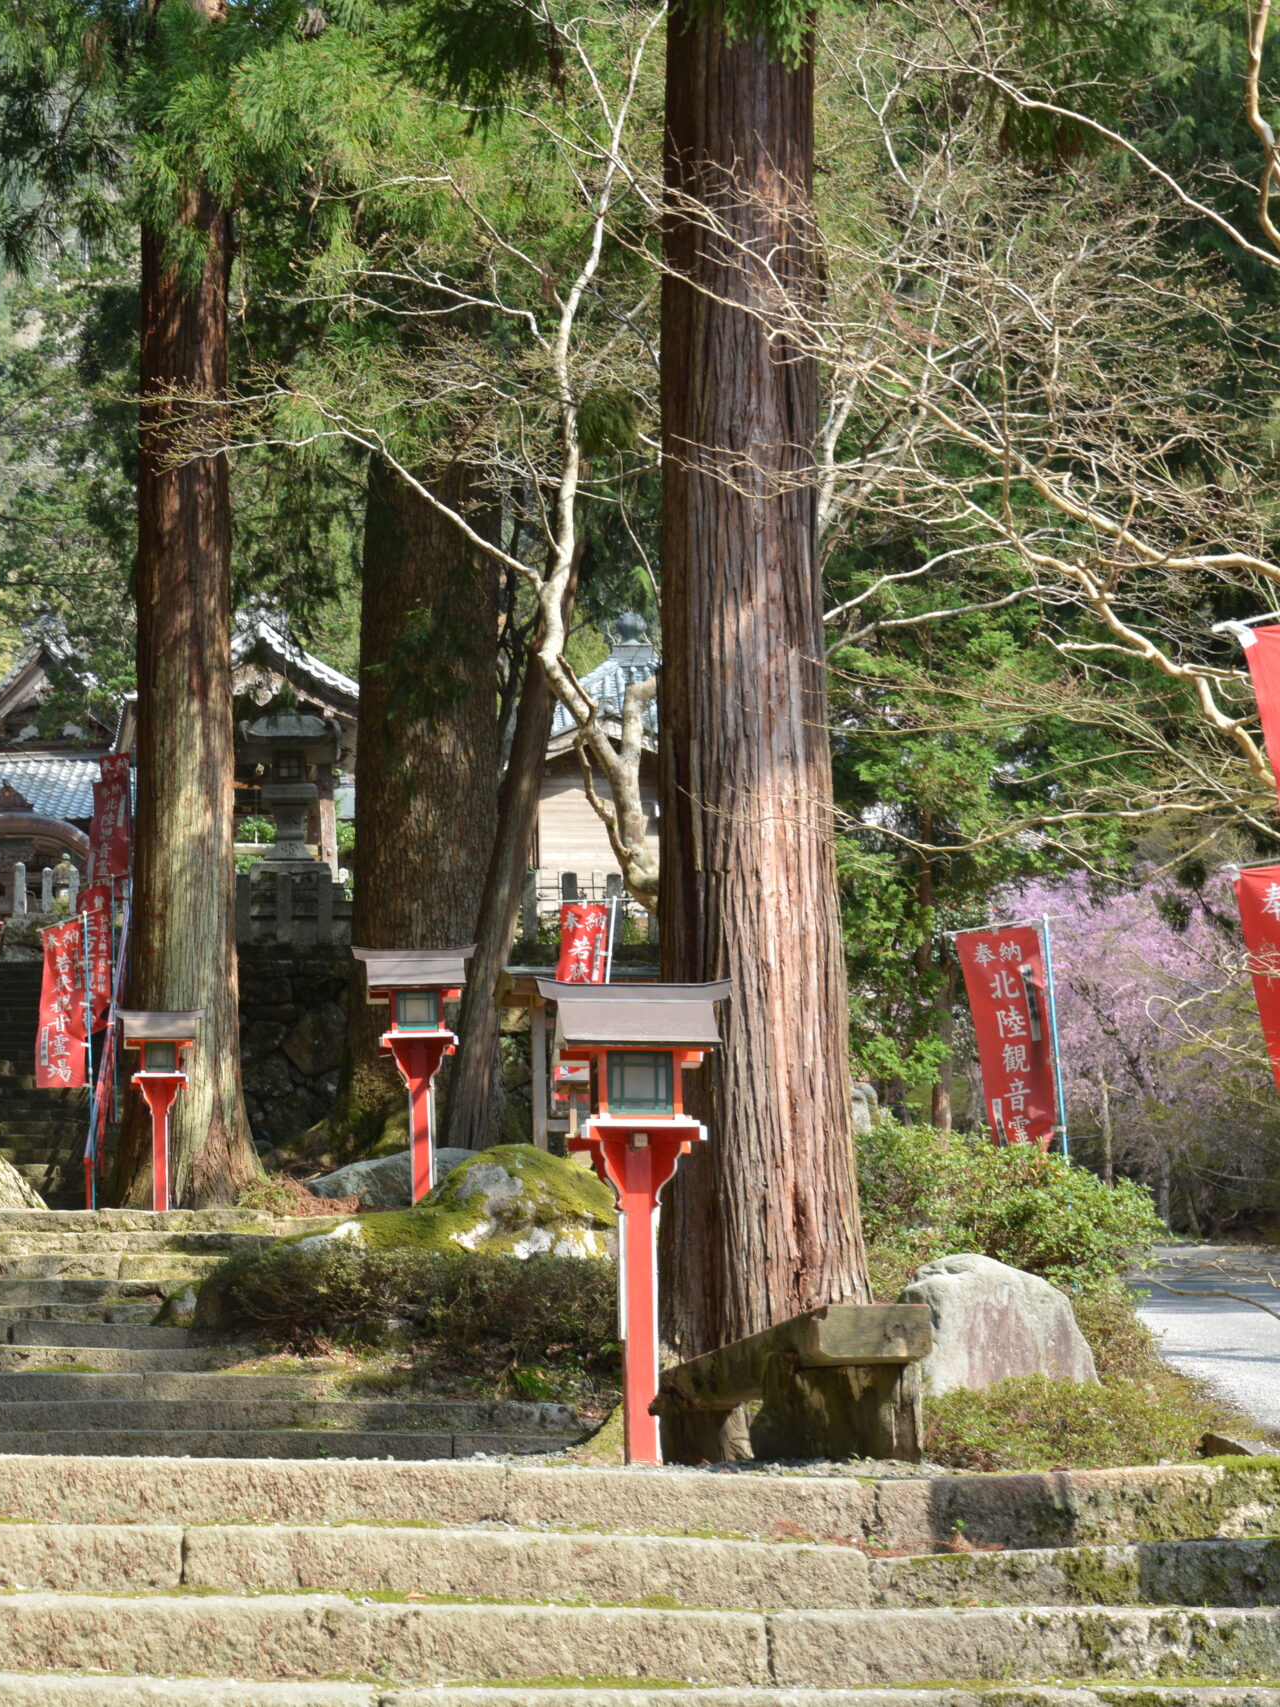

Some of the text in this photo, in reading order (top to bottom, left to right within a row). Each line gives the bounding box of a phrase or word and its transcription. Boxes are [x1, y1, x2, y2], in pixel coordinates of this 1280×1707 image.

[46, 930, 80, 950] 奉納
[562, 911, 608, 932] 奉納
[565, 936, 591, 984] 若狭
[973, 940, 1023, 967] 奉納
[47, 952, 74, 1082] 若狭観音霊場
[989, 970, 1032, 1145] 北陸観音霊
